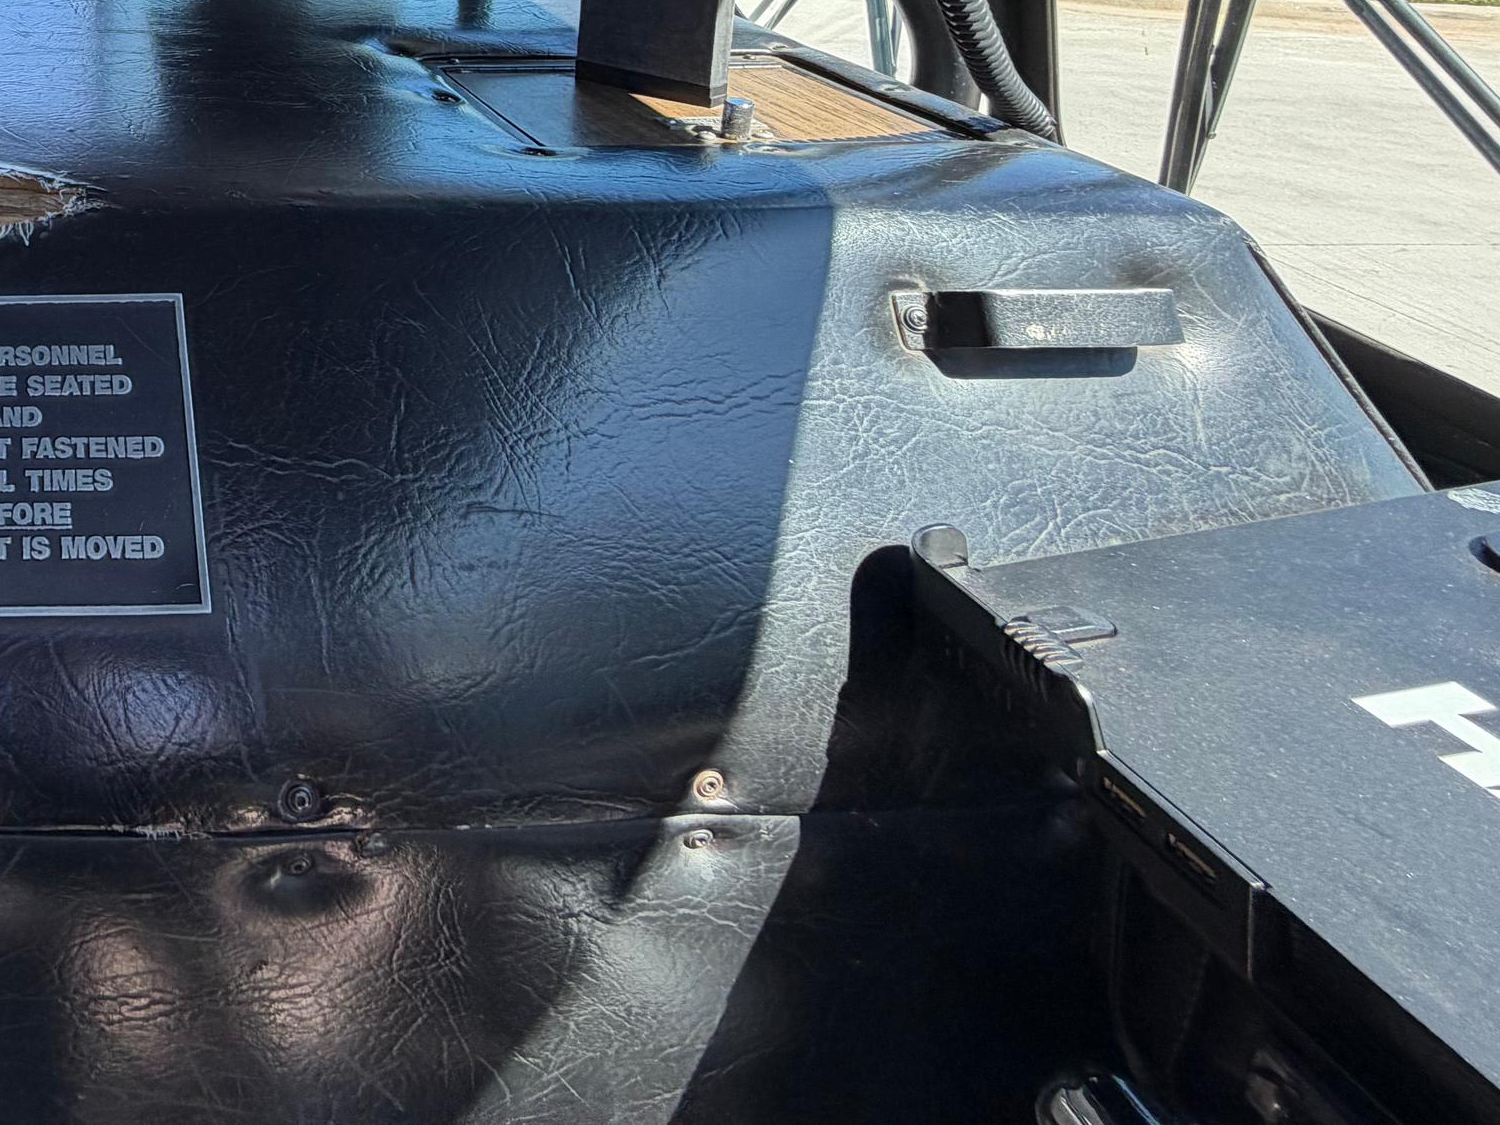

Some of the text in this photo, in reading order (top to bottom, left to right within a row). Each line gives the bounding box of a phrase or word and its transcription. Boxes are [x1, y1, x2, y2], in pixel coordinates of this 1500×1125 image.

[26, 374, 132, 397] SEATED
[21, 437, 164, 459] FASTENED
[25, 469, 113, 492] TIMES
[22, 537, 51, 559] IS
[61, 536, 165, 559] MOVED
